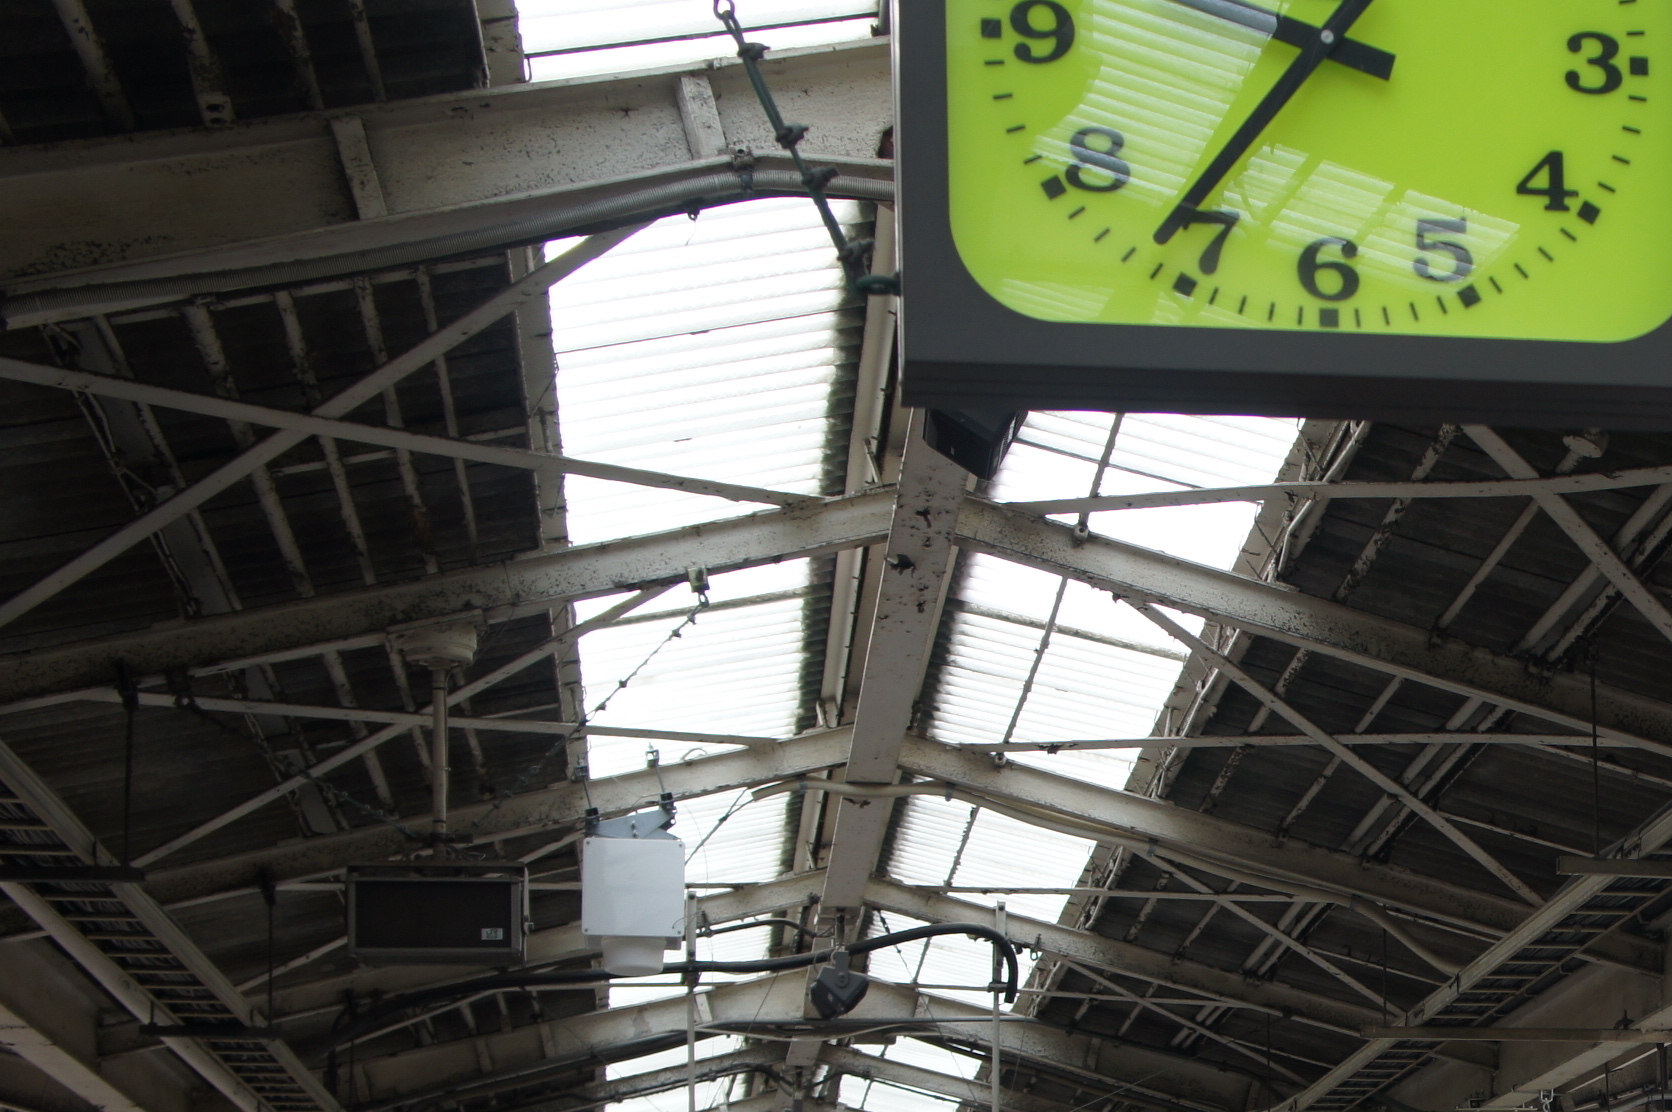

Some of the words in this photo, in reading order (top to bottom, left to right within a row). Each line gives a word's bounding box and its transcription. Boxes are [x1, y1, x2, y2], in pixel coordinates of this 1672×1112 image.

[1008, 0, 1076, 64] 9
[1564, 30, 1623, 95] 3
[1065, 126, 1131, 193] 8
[1516, 150, 1579, 213] 4
[1181, 209, 1241, 276] 7
[1297, 235, 1362, 303] 6
[1412, 216, 1476, 283] 5
